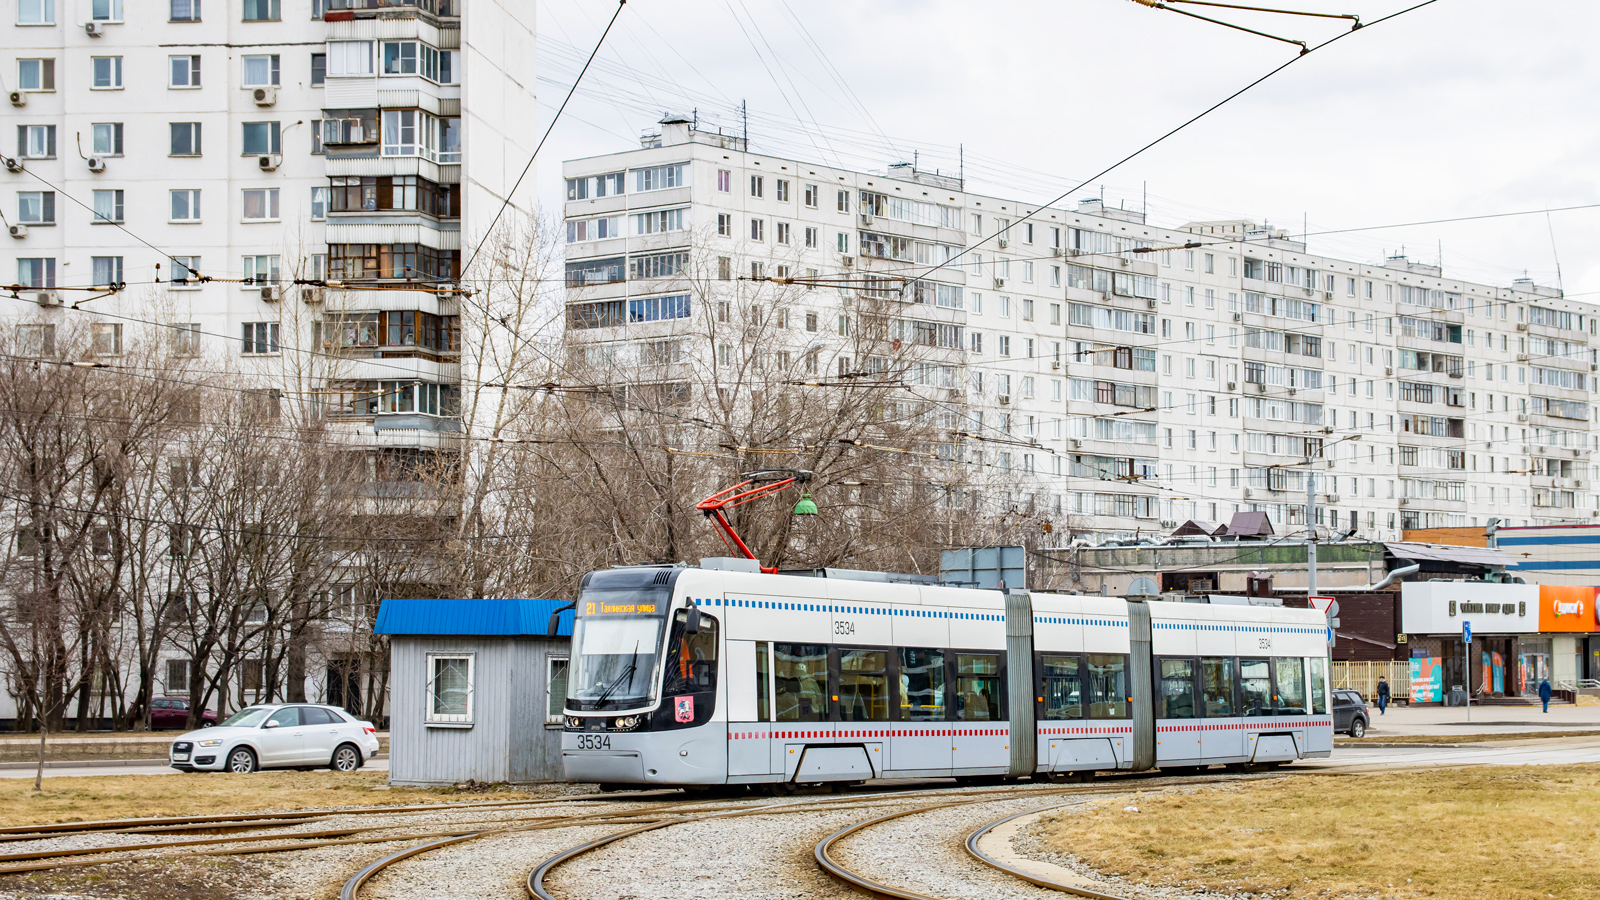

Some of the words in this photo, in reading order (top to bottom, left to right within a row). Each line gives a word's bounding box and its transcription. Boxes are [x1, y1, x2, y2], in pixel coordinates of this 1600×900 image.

[586, 602, 595, 614] 21
[637, 604, 655, 613] улица
[834, 621, 854, 635] 3534
[1259, 638, 1270, 649] 3534
[577, 735, 611, 749] 3534
